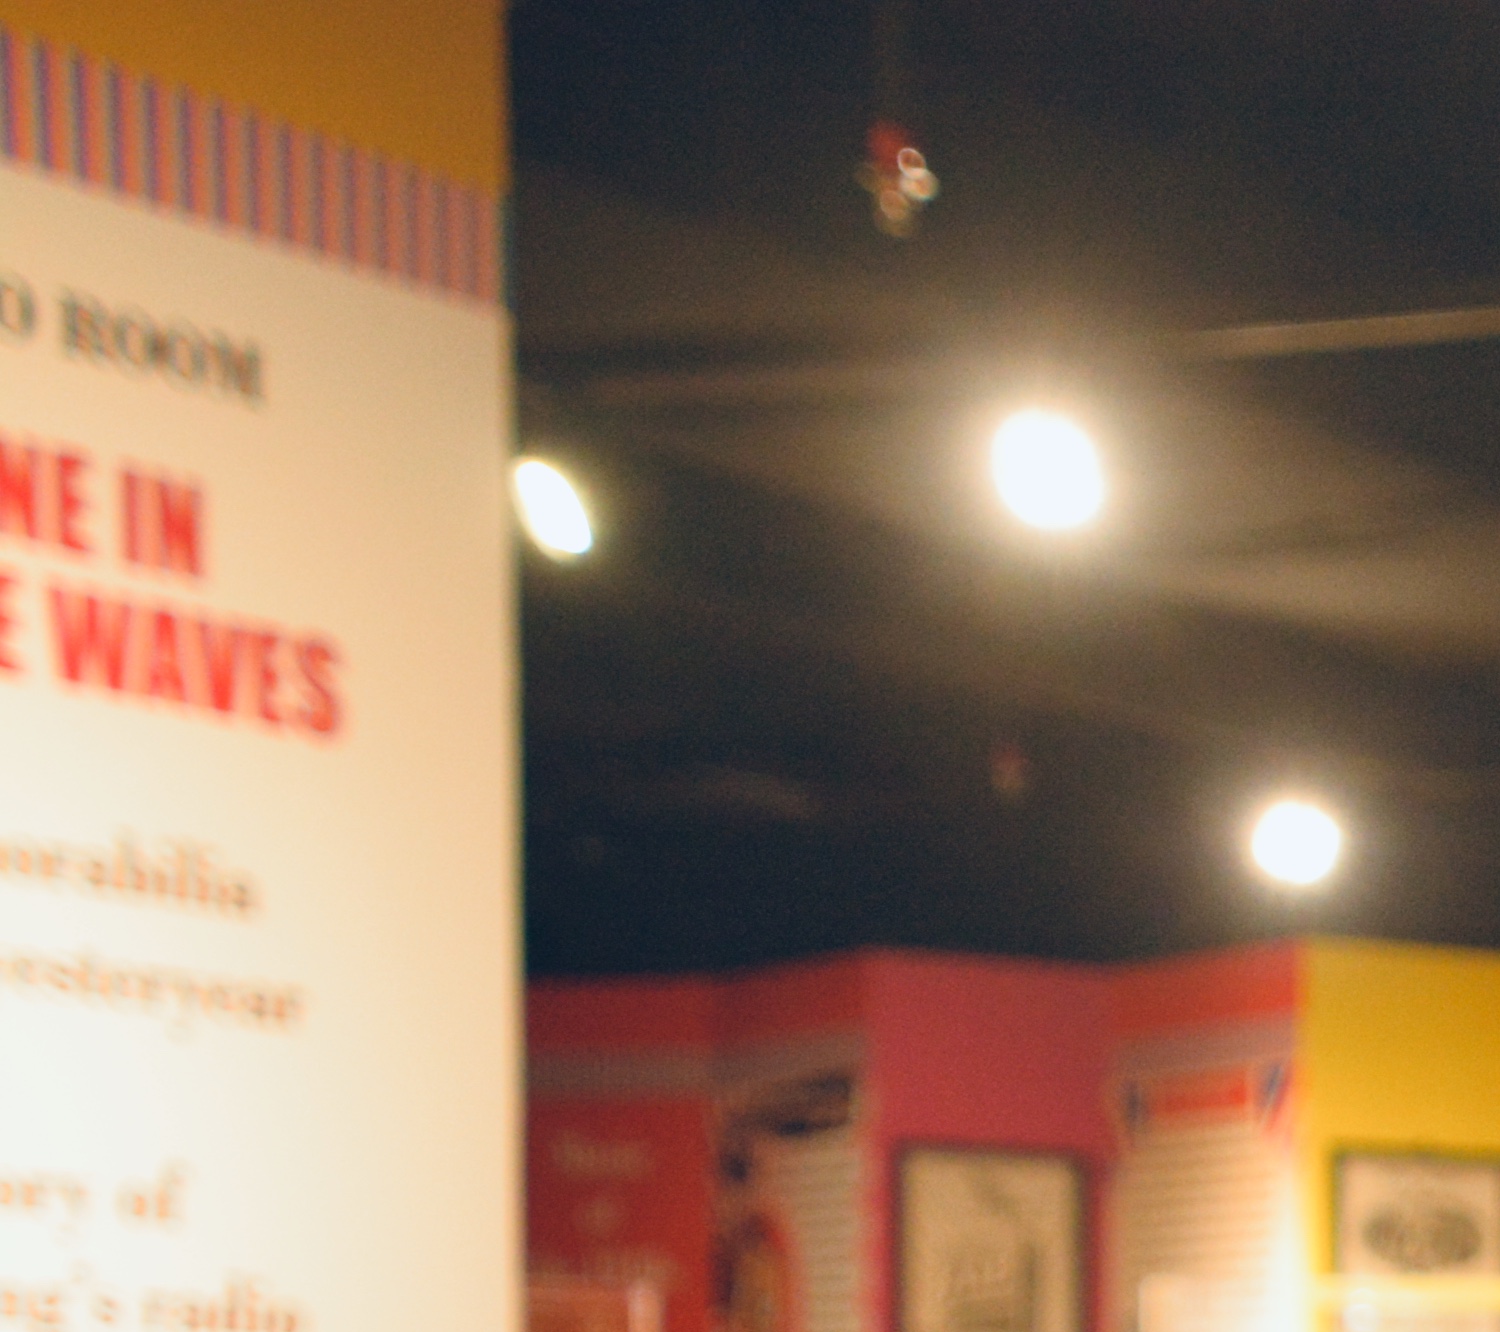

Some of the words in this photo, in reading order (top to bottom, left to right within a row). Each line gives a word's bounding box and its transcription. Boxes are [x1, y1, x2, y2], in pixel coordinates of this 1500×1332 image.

[62, 286, 264, 402] ROOM
[122, 460, 206, 582] IN
[48, 586, 344, 740] WAVES
